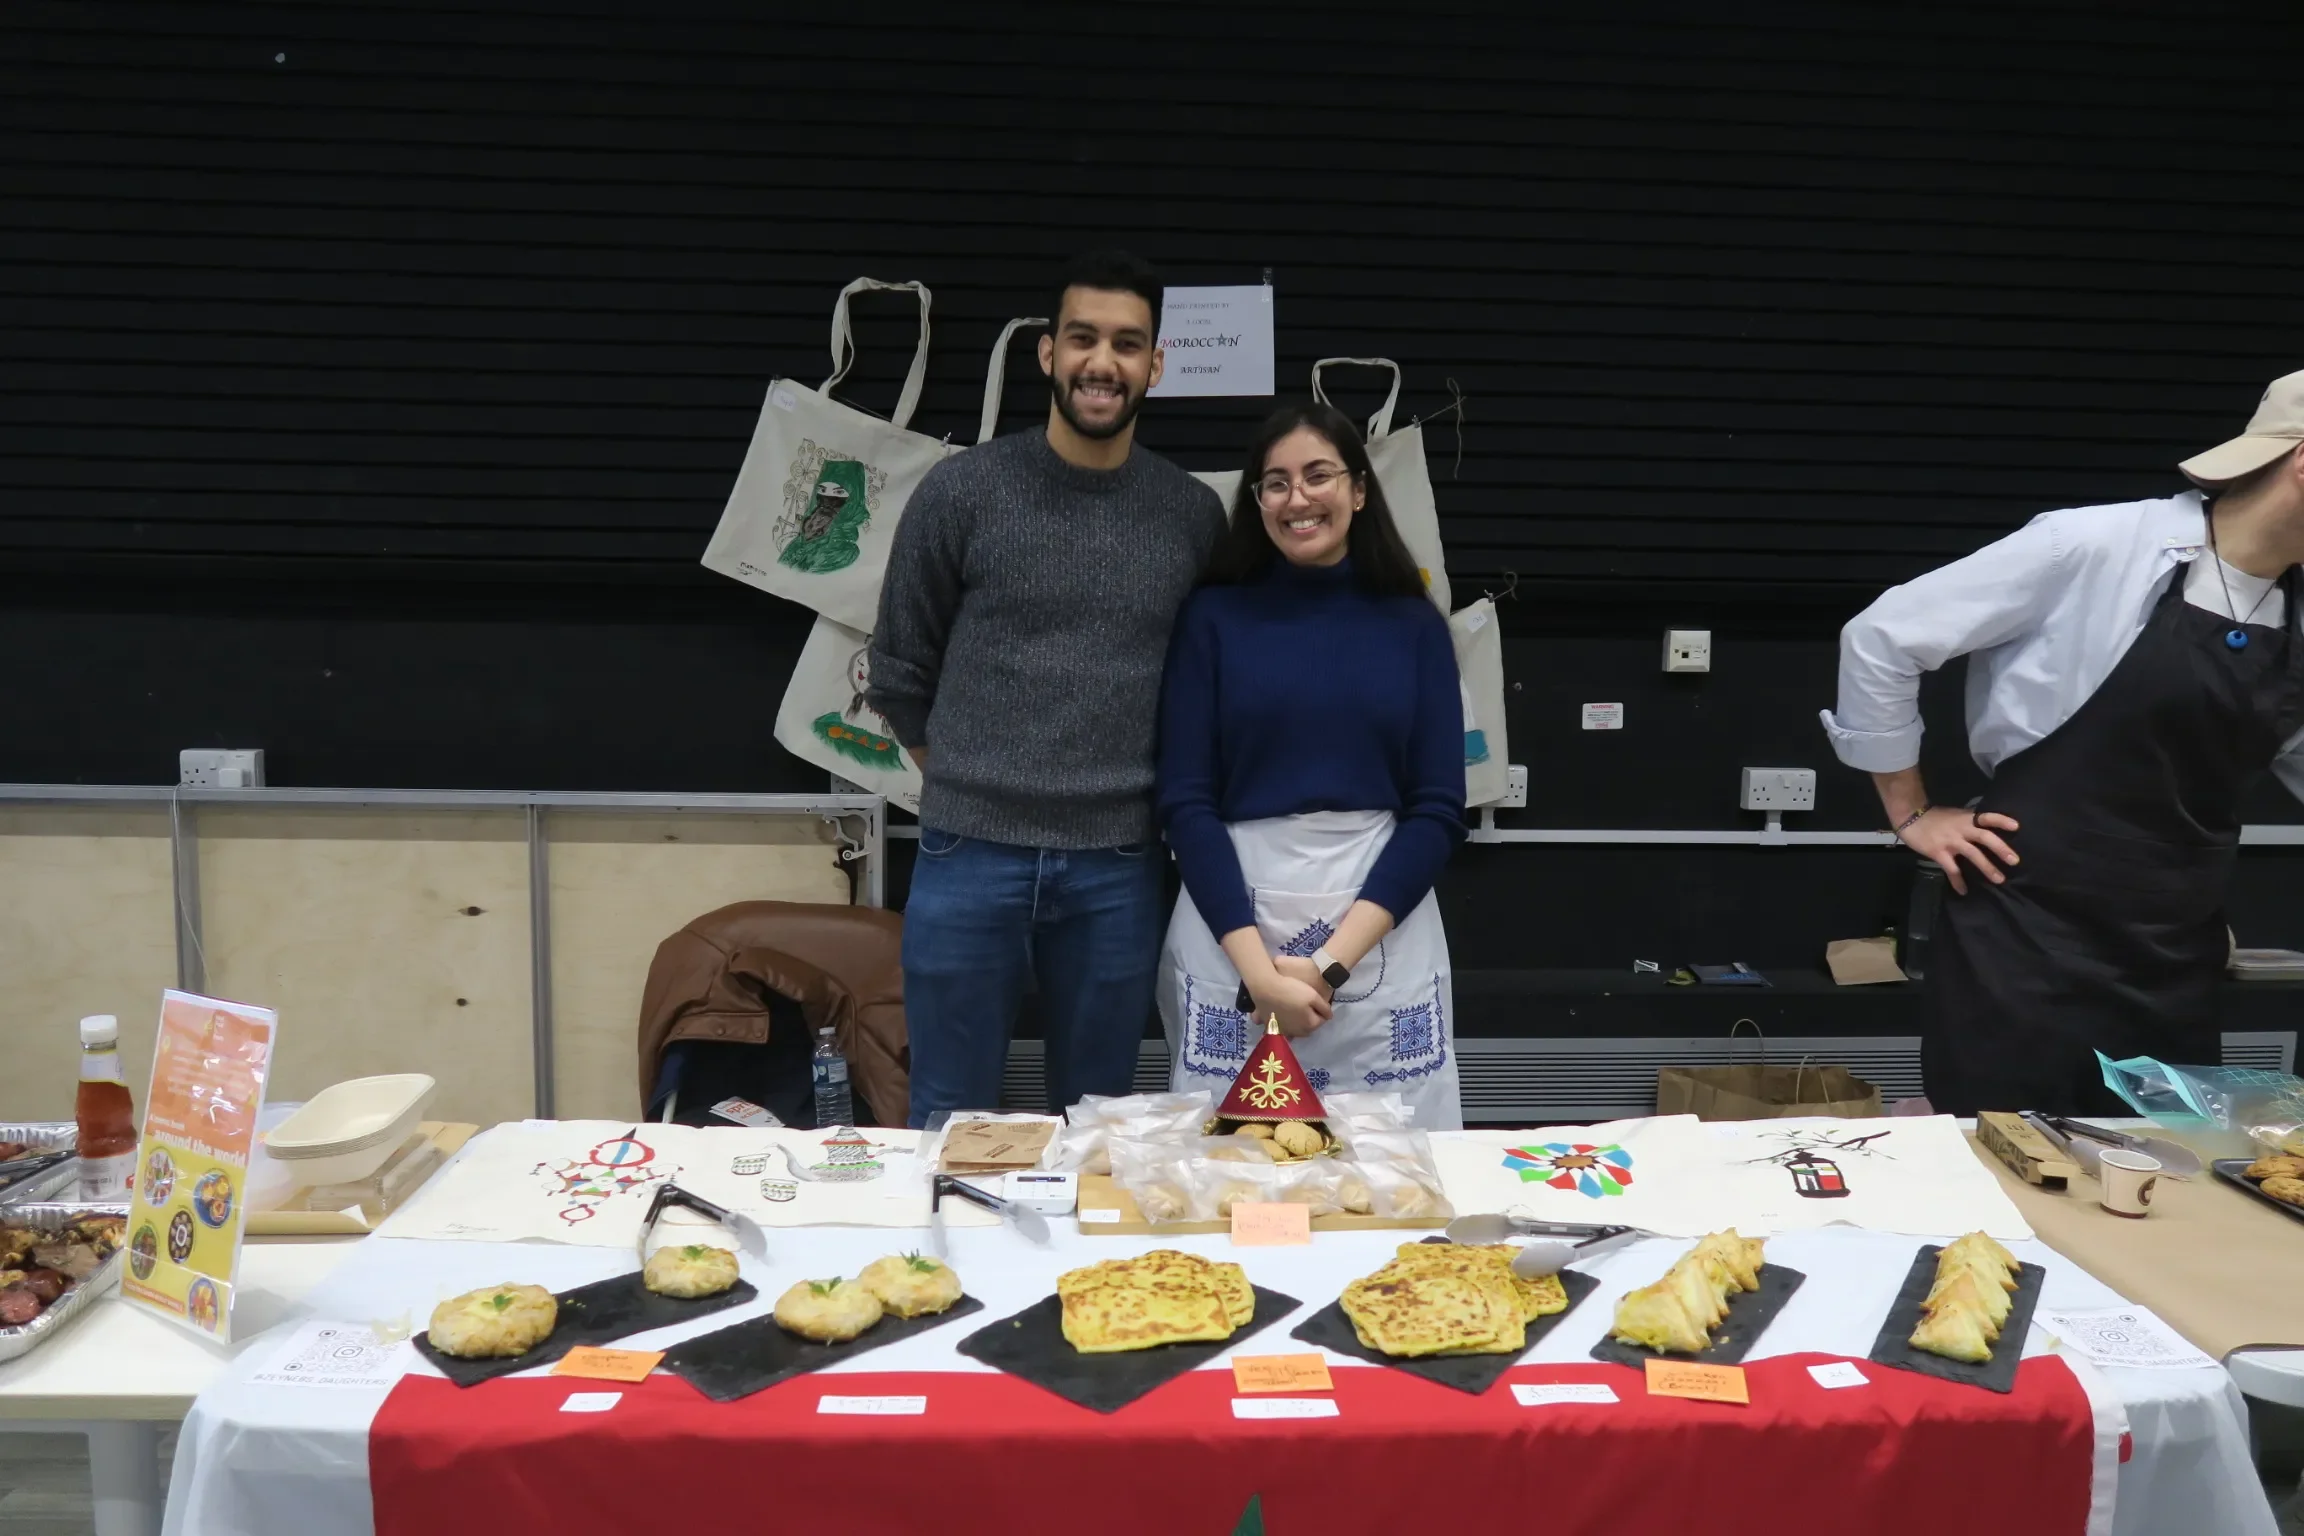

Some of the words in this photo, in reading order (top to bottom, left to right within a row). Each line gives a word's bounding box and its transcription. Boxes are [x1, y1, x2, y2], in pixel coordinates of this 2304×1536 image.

[1180, 364, 1222, 374] ARTISAN
[153, 1130, 192, 1150] around
[192, 1139, 213, 1156] the
[213, 1147, 247, 1168] world
